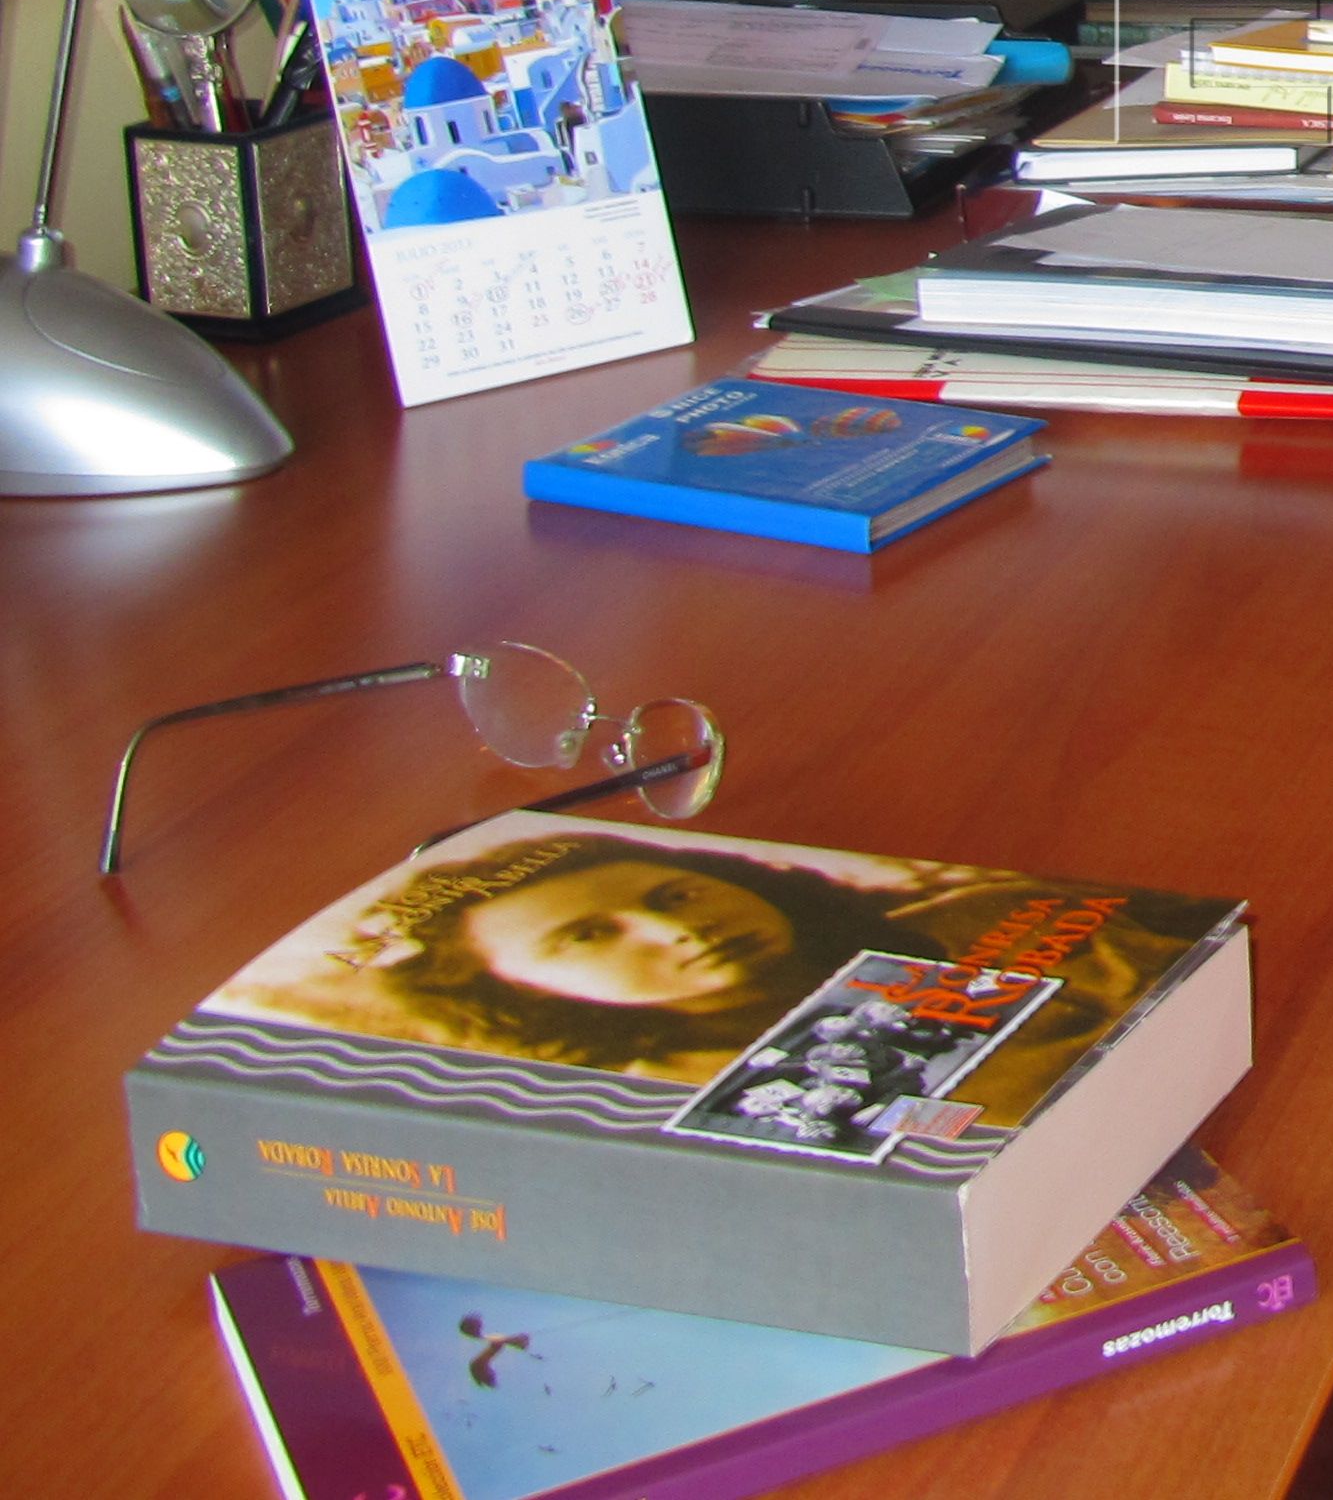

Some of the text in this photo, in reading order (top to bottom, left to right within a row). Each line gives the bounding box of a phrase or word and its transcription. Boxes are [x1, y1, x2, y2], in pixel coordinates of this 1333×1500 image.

[641, 761, 679, 781] CHANEL
[911, 897, 1130, 1030] ROBADA
[340, 1149, 422, 1189] SONRISA
[428, 1163, 457, 1194] LA
[386, 1197, 464, 1236] ANTONIO
[1102, 1300, 1236, 1358] Torremozas
